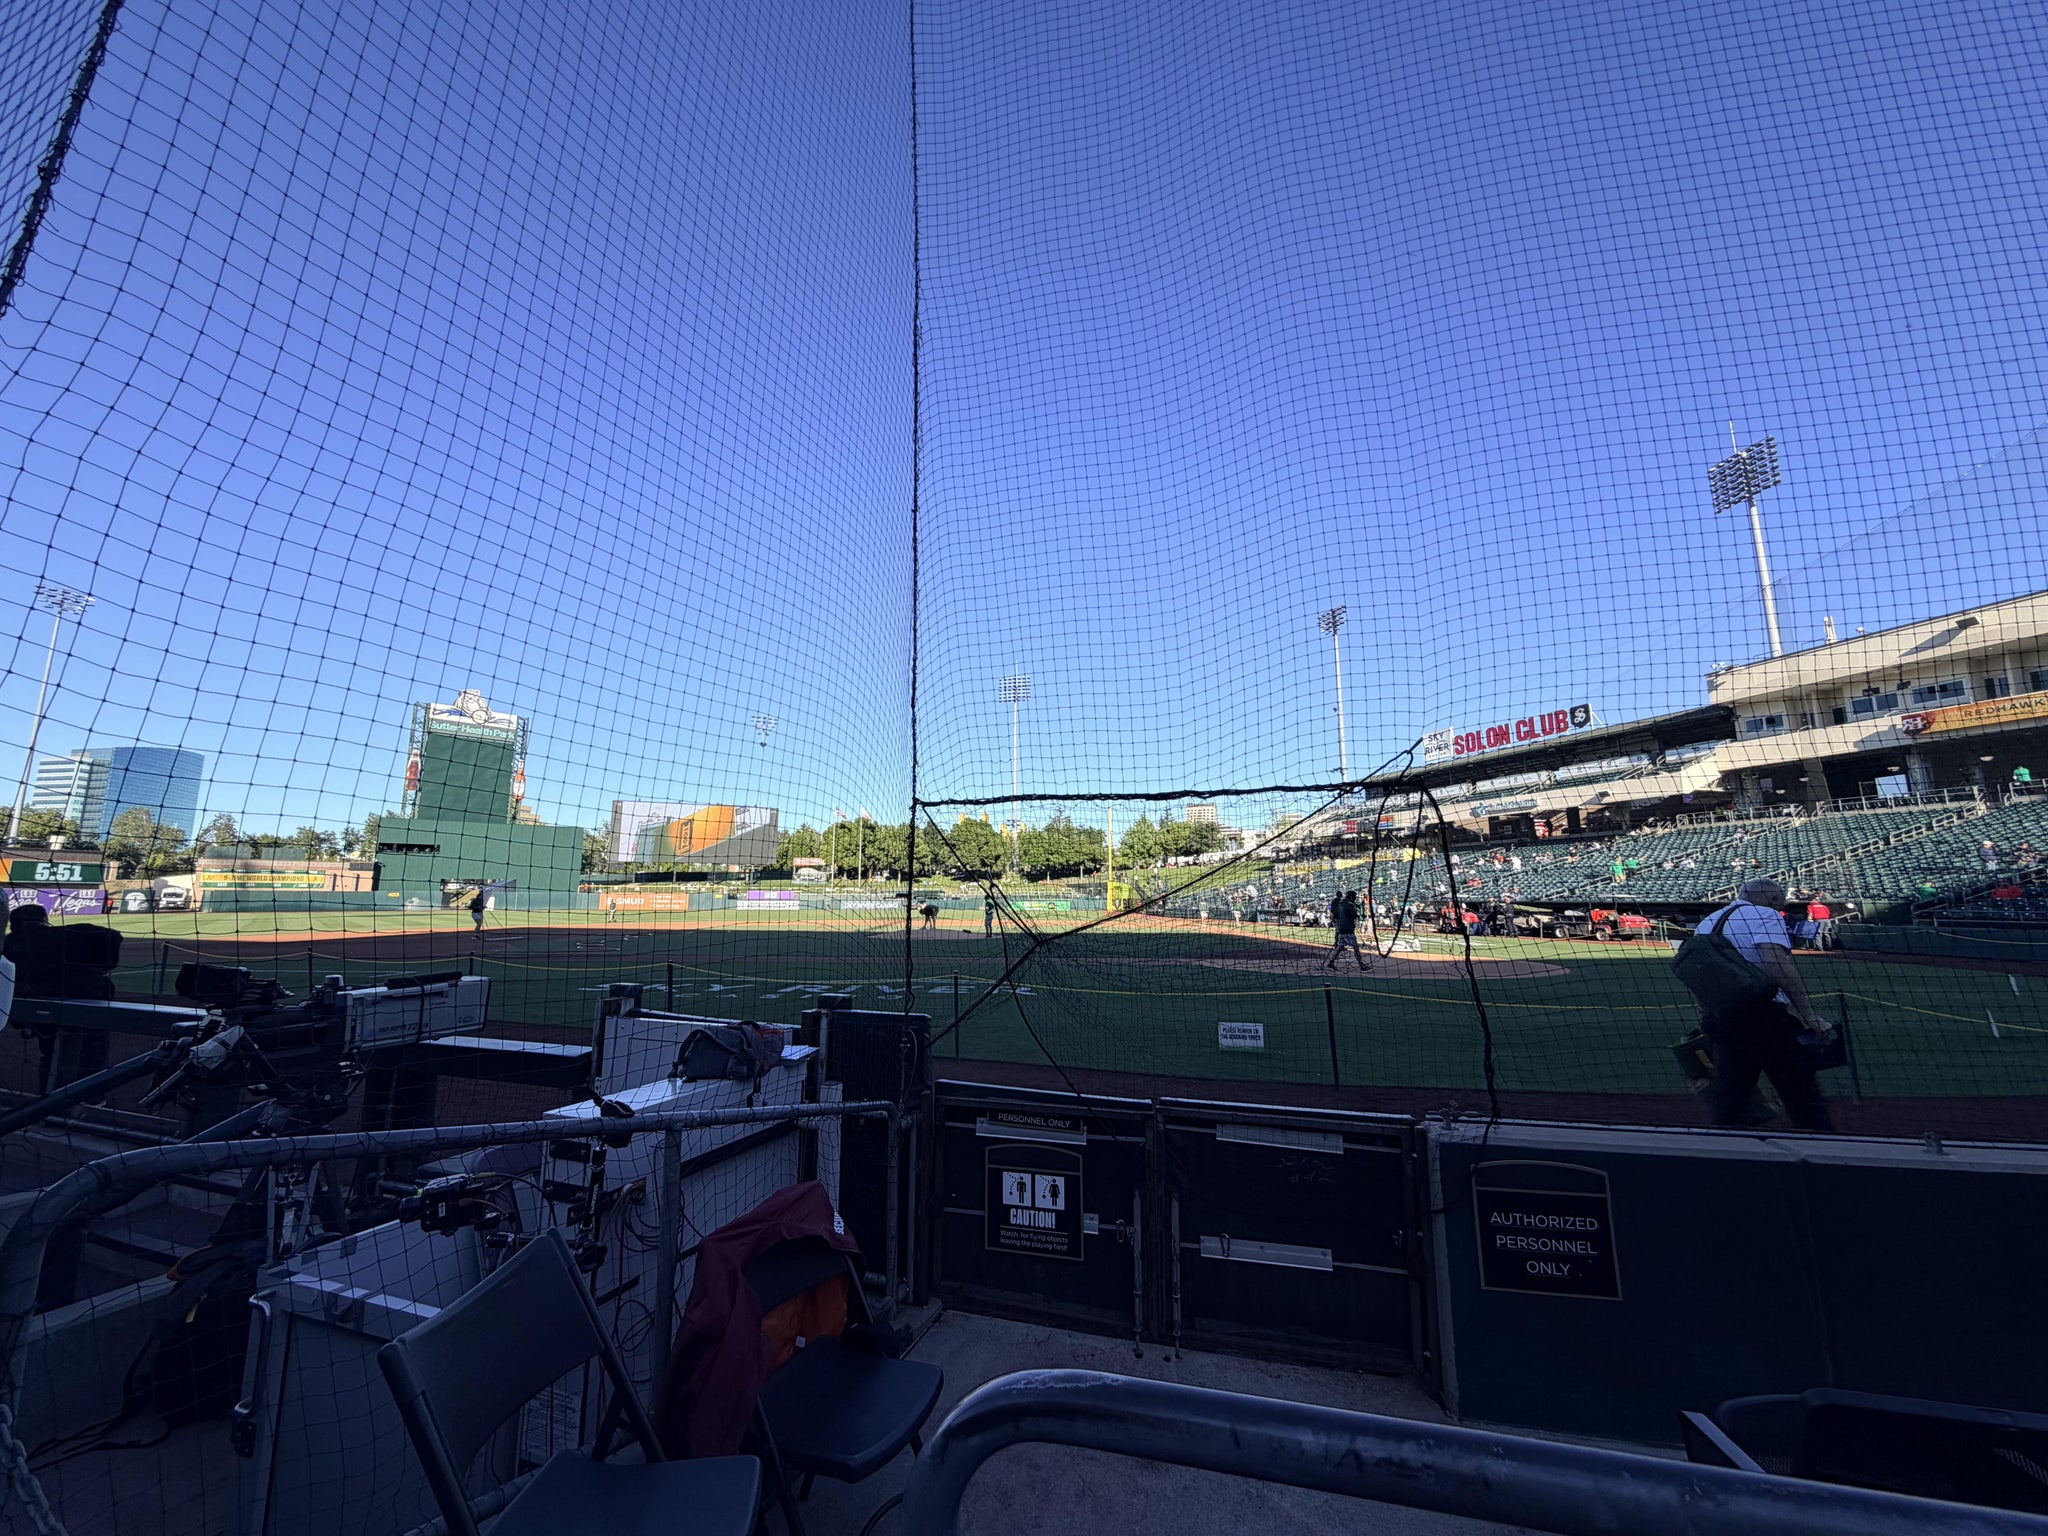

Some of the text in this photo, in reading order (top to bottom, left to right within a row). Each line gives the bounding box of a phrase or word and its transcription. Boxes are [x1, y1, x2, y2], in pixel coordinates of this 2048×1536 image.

[429, 721, 515, 738] Sutter Health Park
[1427, 731, 1444, 743] SKY
[1454, 709, 1569, 756] SOLON CLUB
[1425, 742, 1449, 754] RIVER
[34, 862, 83, 881] 5:51
[20, 889, 38, 898] LAS
[79, 889, 96, 898] LAS
[616, 897, 645, 905] SMUD
[49, 891, 102, 915] Vegas
[998, 1112, 1071, 1129] PERSONNEL ONLY
[1009, 1208, 1056, 1229] CAUTION!
[1490, 1211, 1598, 1230] AUTHORIZED
[1000, 1230, 1018, 1238] Watch
[1029, 1232, 1046, 1241] flying
[1046, 1235, 1068, 1244] objects
[1000, 1237, 1020, 1246] leaving
[1031, 1240, 1053, 1250] playing
[1495, 1234, 1599, 1255] PERSONNEL
[1526, 1260, 1571, 1276] ONLY
